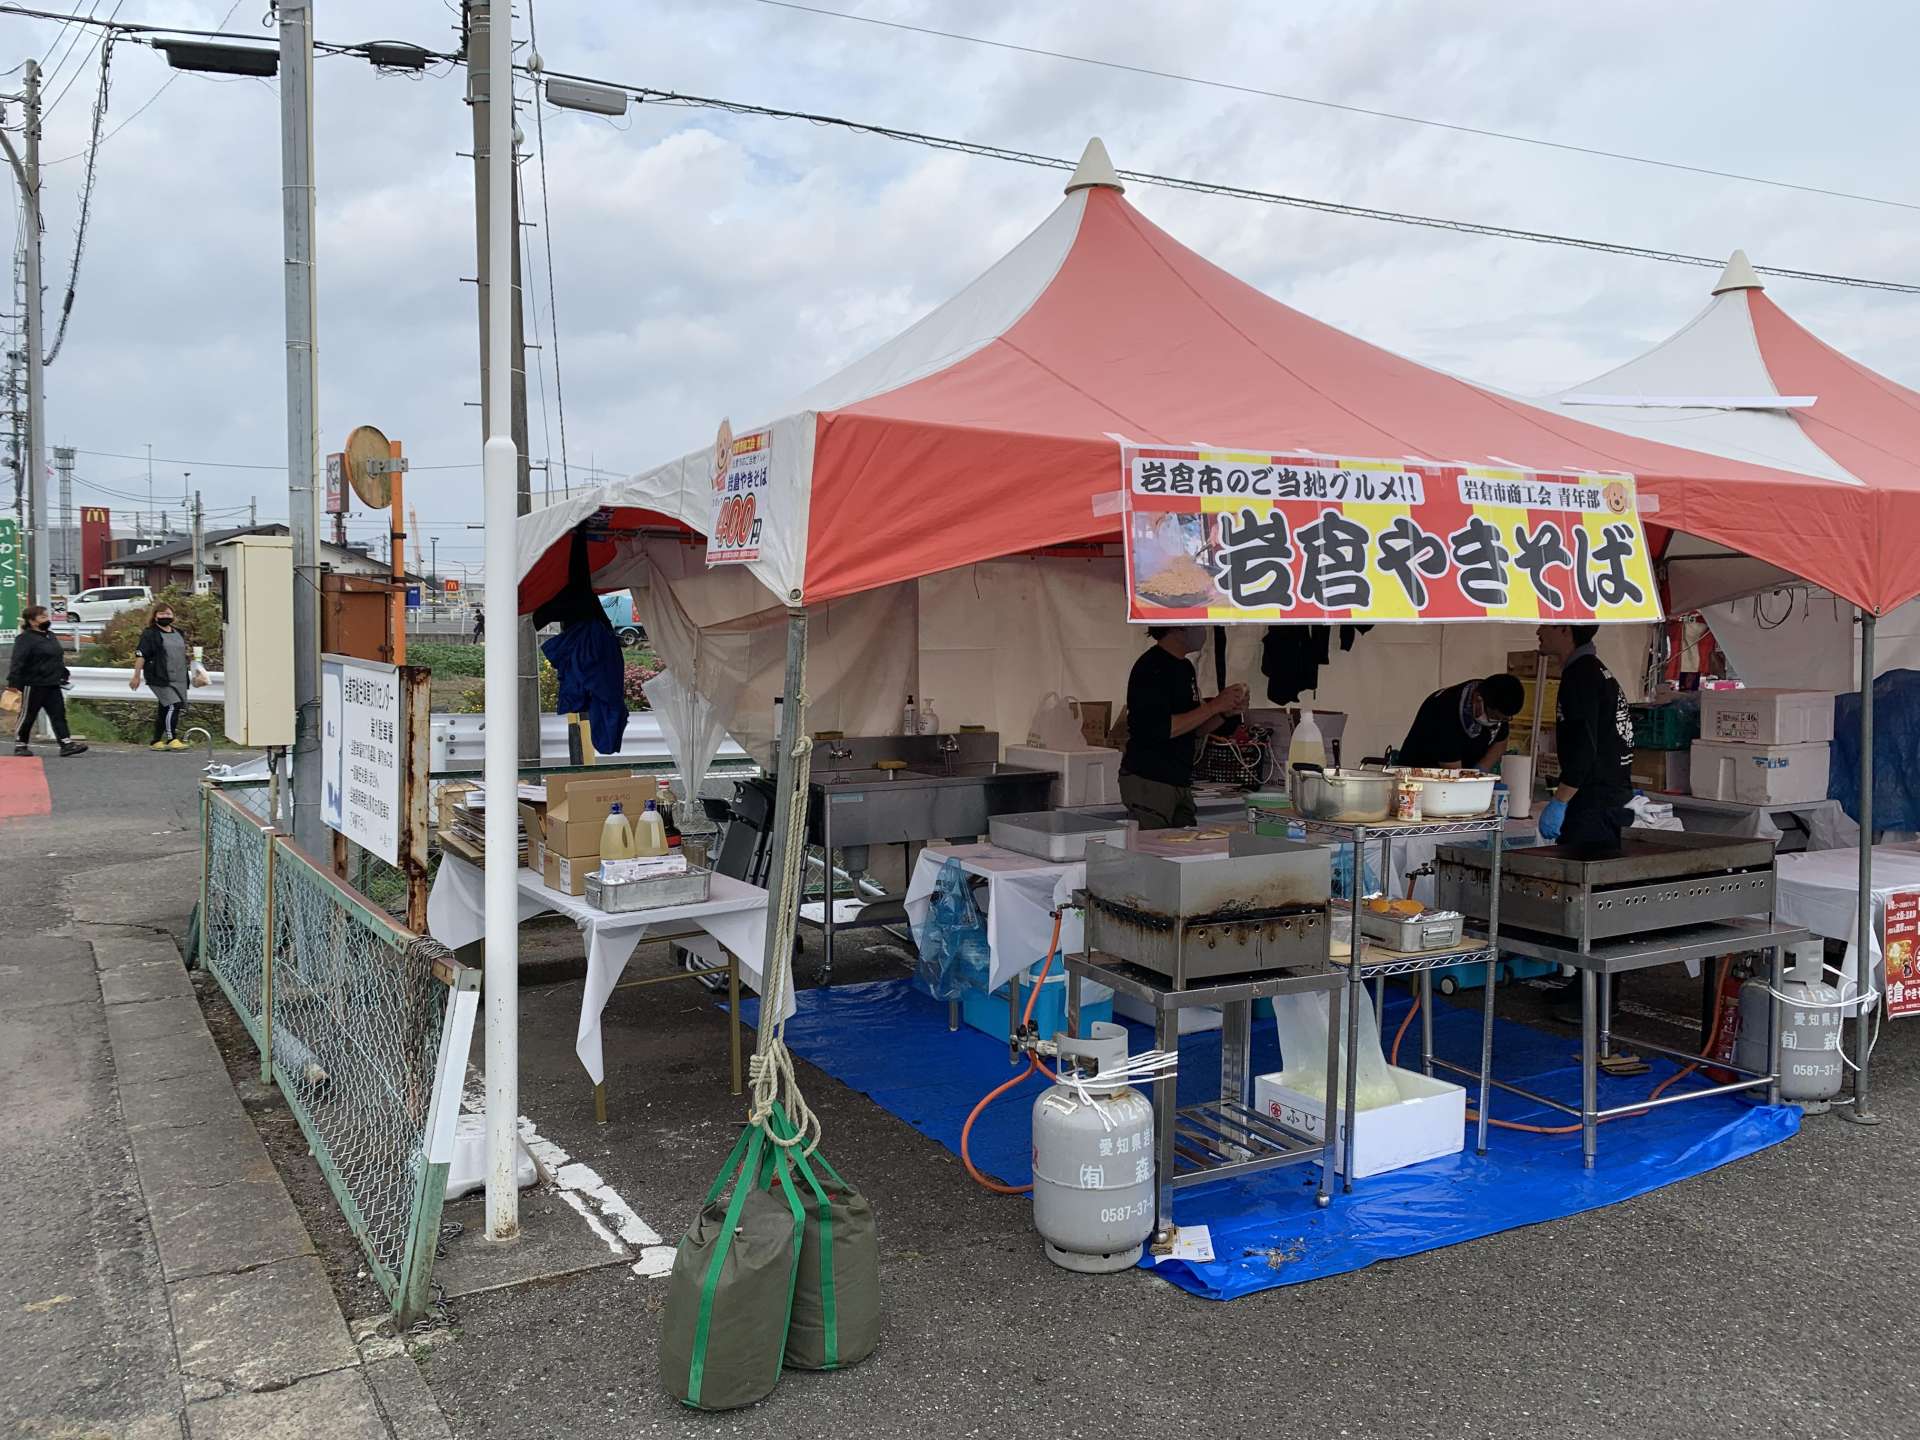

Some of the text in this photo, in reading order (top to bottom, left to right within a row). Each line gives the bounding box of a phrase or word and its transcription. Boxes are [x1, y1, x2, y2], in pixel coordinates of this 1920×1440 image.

[728, 466, 767, 492] 岩倉やきそば
[1464, 480, 1600, 509] 岩倉市商工会 青年部
[1215, 508, 1643, 609] 岩倉やきそば
[1287, 1109, 1316, 1132] ふじ
[1136, 1157, 1150, 1184] 森
